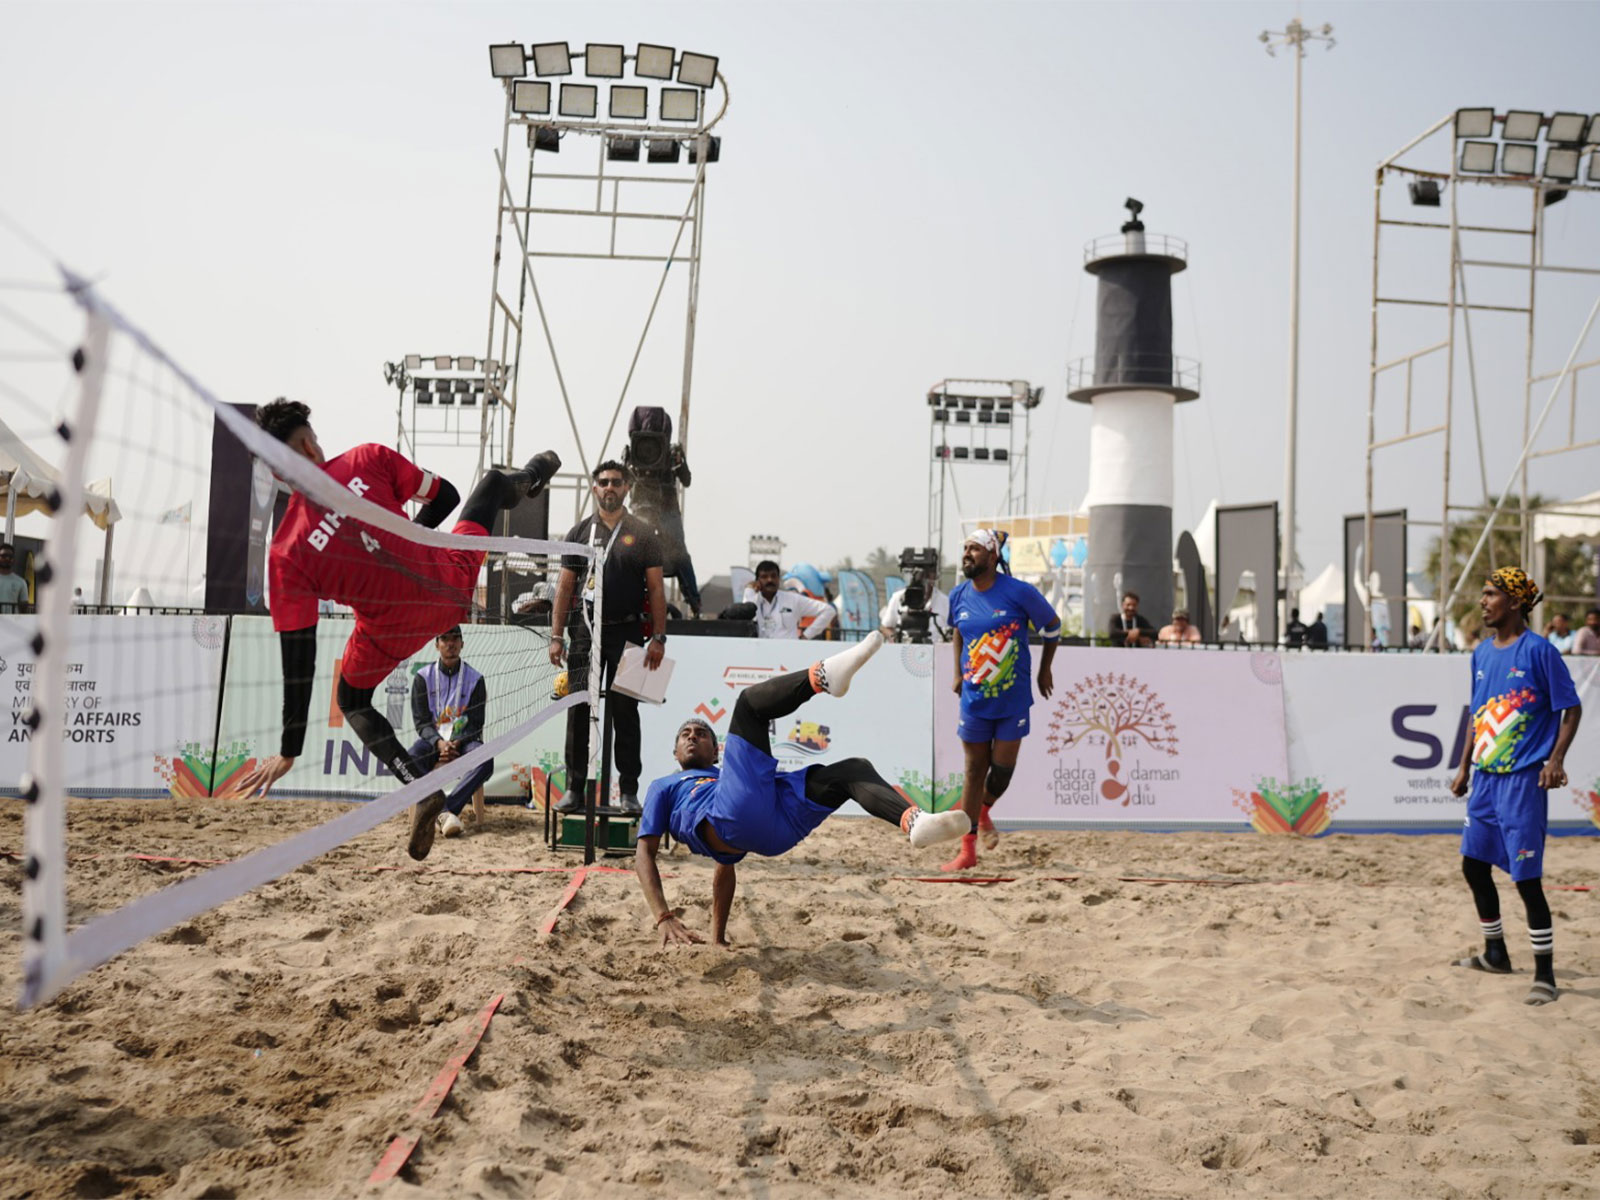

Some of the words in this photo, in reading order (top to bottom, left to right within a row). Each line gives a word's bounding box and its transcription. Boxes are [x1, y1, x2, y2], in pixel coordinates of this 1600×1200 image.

[307, 477, 371, 552] BIHR
[360, 530, 381, 553] 4
[83, 696, 102, 709] OF
[73, 712, 142, 727] AFFAIRS
[8, 729, 33, 743] AN
[62, 729, 116, 743] PORTS
[1053, 758, 1096, 780] dadra
[1130, 759, 1180, 781] daman
[1054, 780, 1096, 793] nagar
[1131, 783, 1156, 806] diu
[1055, 790, 1099, 806] haveli
[1393, 795, 1430, 805] SPORTS
[1432, 795, 1468, 805] AUTHOR
